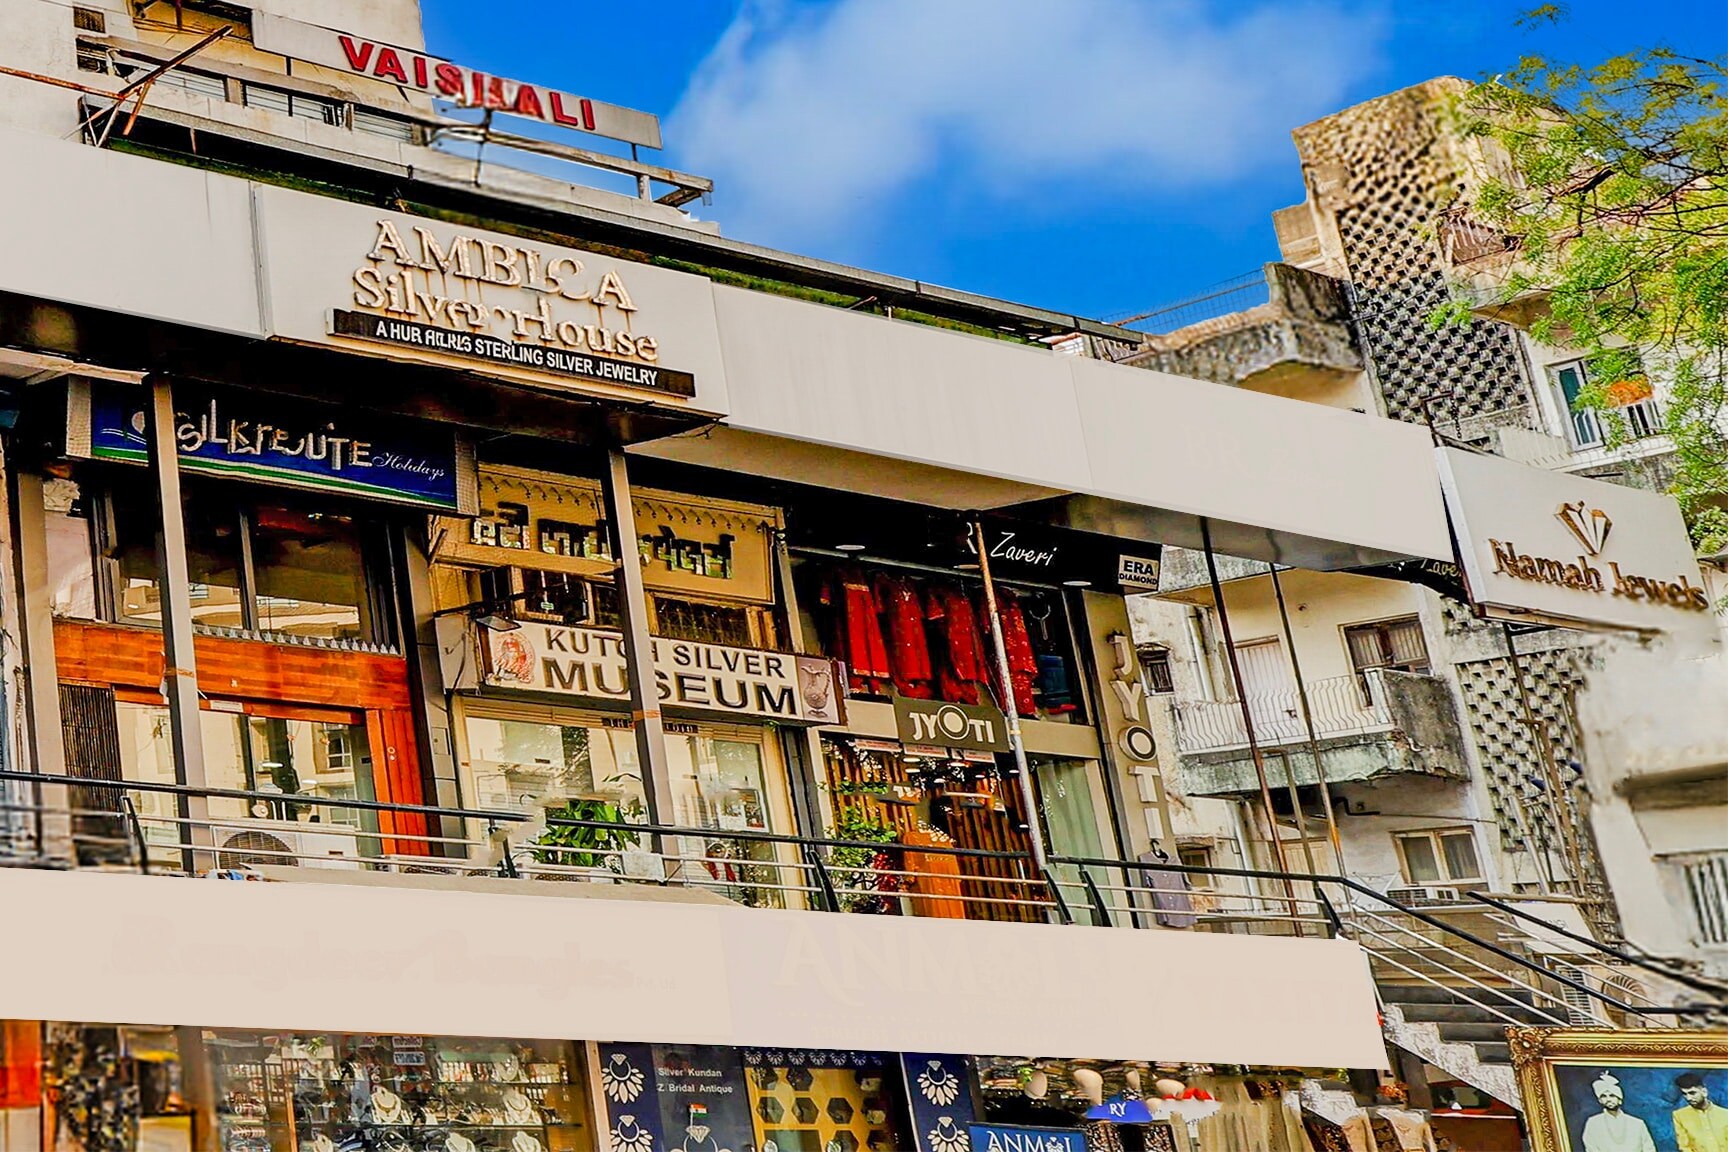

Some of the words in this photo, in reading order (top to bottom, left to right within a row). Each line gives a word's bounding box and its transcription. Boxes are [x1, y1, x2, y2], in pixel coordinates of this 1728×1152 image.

[376, 323, 388, 338] A
[475, 337, 543, 366] STERLING
[546, 351, 593, 376] SILVER
[595, 361, 658, 387] JEWELRY
[373, 452, 445, 481] Holidays
[990, 531, 1058, 566] Zaveri
[1119, 572, 1158, 585] DIAMOND
[1124, 559, 1154, 576] ERA
[673, 643, 786, 679] SILVER
[541, 656, 798, 715] MUSEUM
[909, 704, 995, 744] JYOTI
[1106, 633, 1165, 840] JYOTI
[658, 1068, 684, 1077] Silver
[688, 1068, 723, 1078] Kundan
[668, 1083, 695, 1093] Bridal
[699, 1084, 734, 1095] Antique
